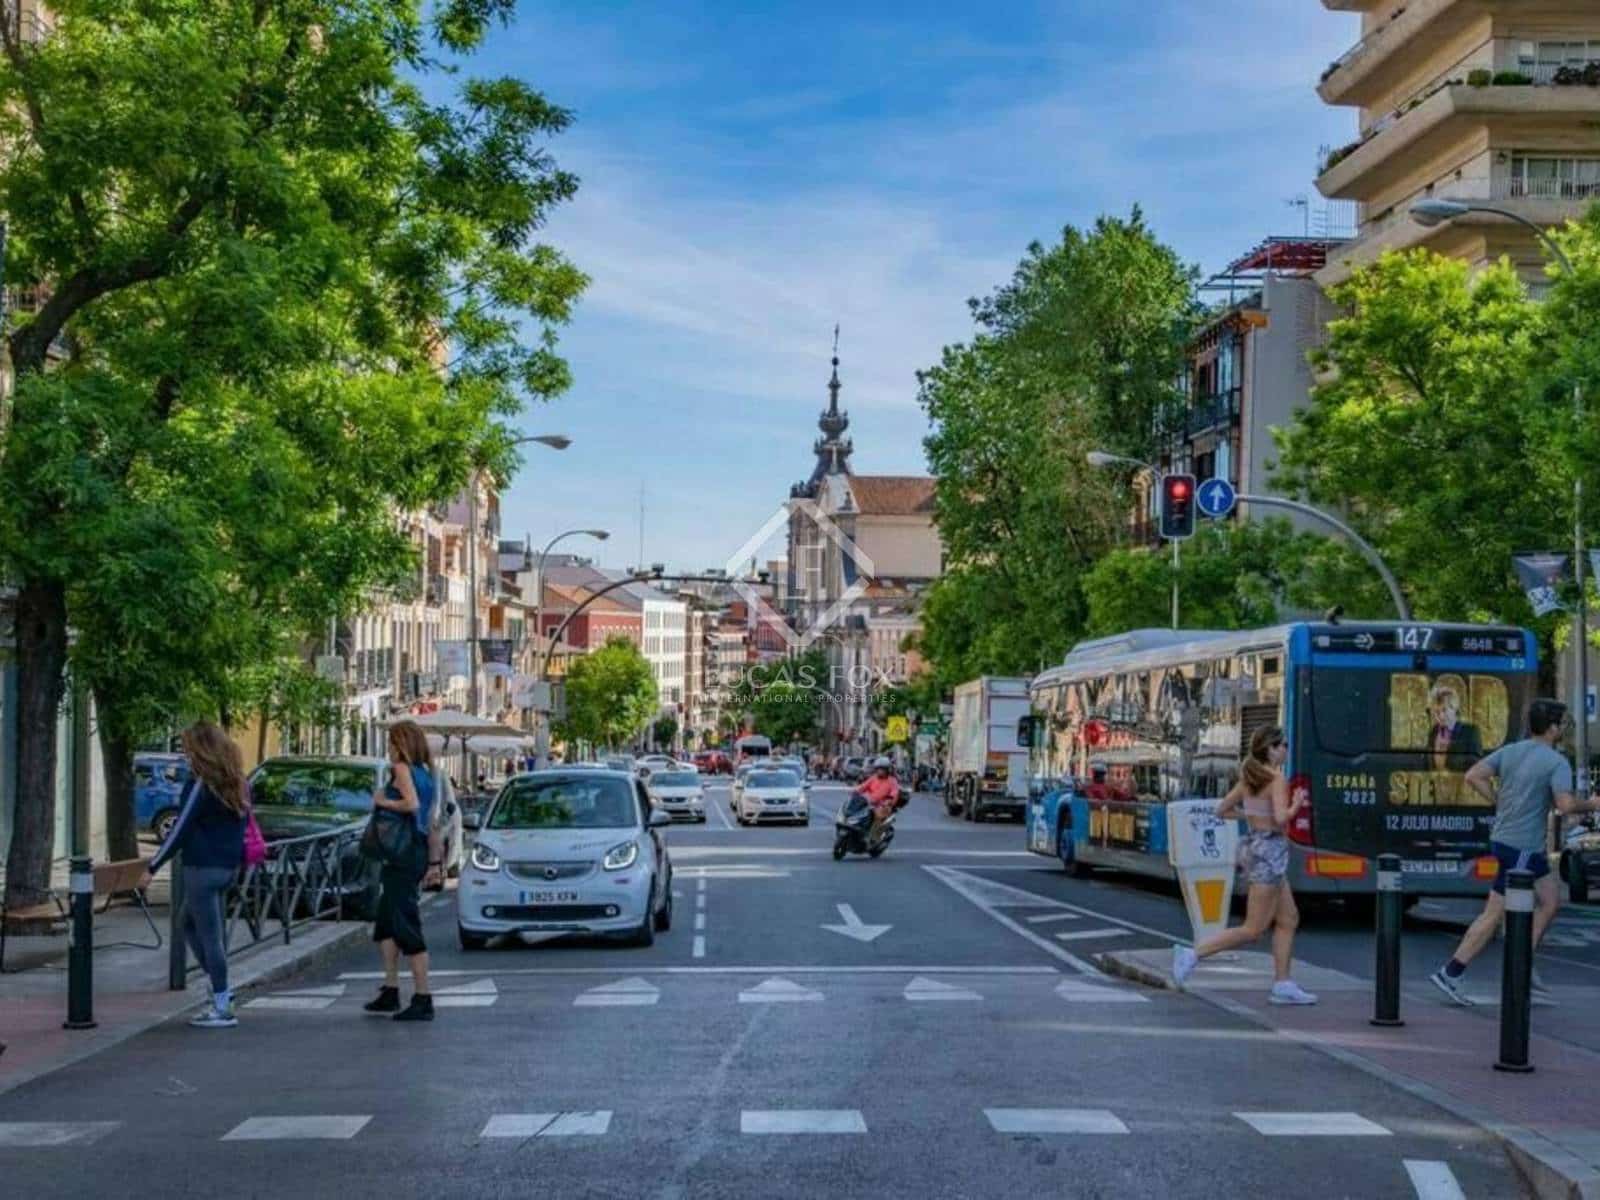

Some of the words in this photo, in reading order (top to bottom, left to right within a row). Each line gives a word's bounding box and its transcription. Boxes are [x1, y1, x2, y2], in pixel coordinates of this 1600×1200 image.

[1397, 627, 1433, 650] 147
[1326, 772, 1377, 789] ESPAÑA
[1343, 790, 1377, 805] 2023
[1386, 815, 1400, 831] 12
[1401, 815, 1429, 831] JULIO
[1430, 815, 1475, 831] MADRID
